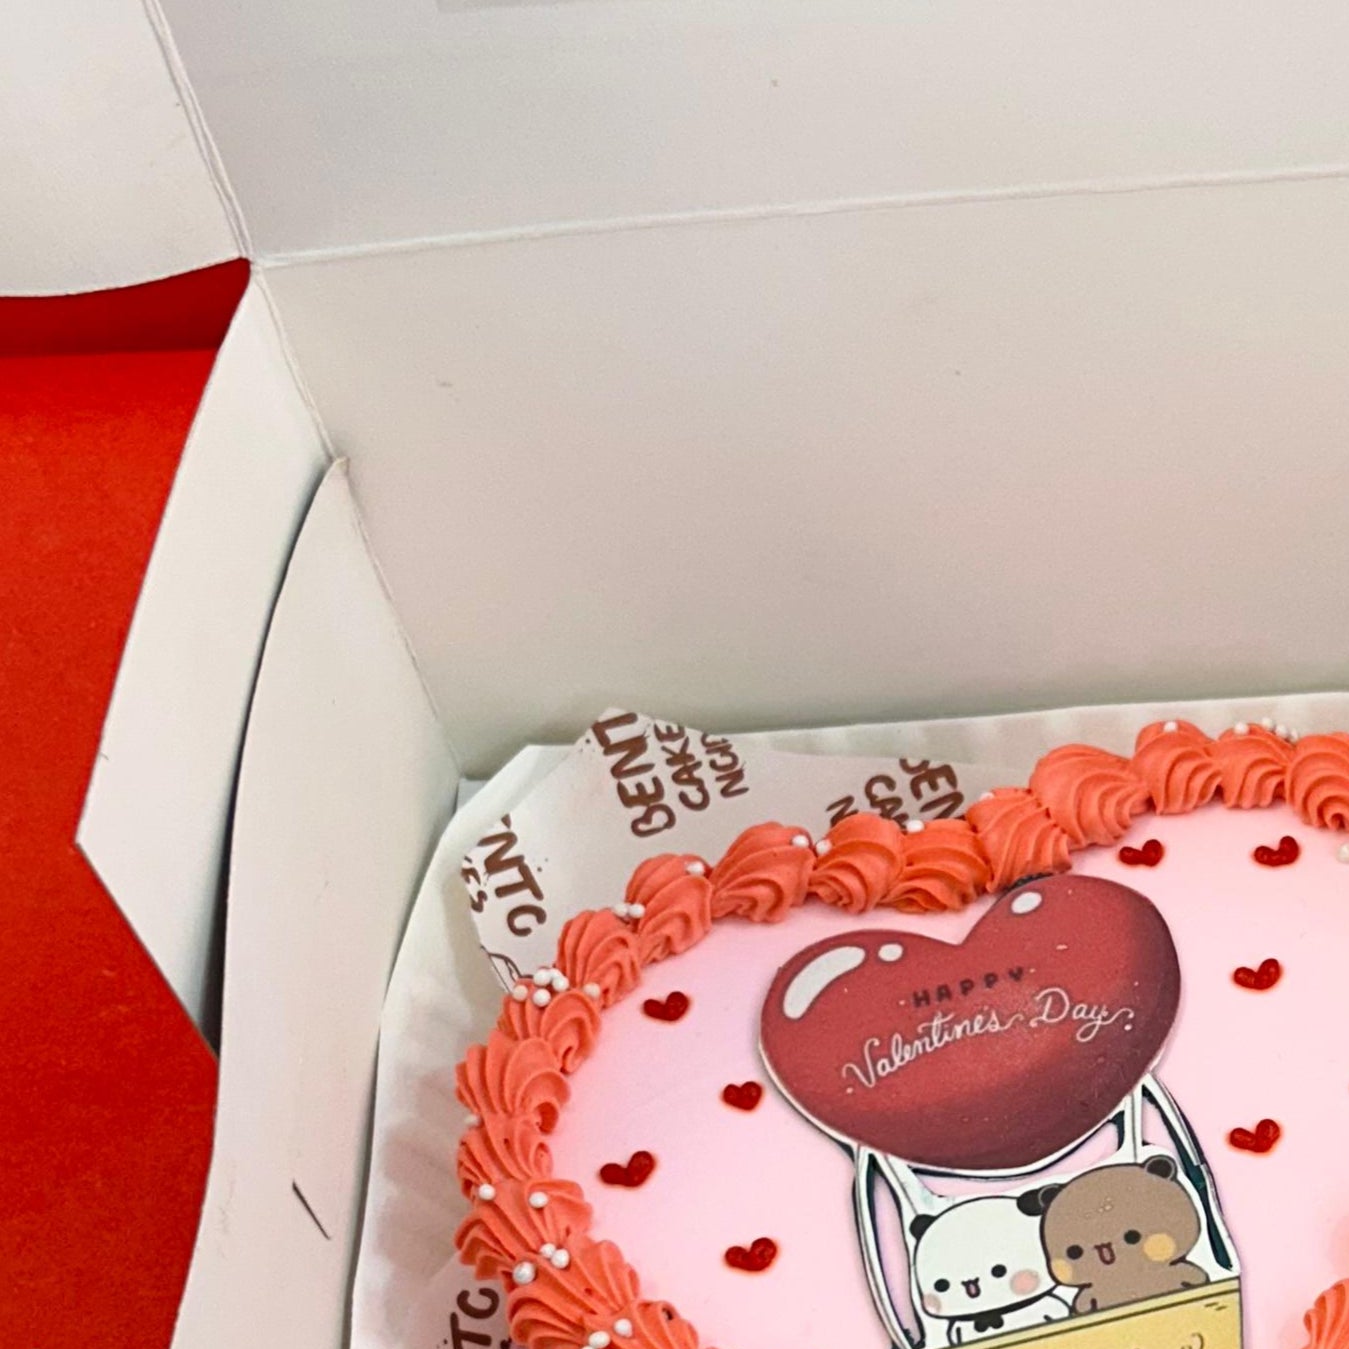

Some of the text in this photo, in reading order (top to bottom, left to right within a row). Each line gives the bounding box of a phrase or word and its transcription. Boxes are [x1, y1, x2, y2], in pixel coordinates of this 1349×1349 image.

[592, 711, 677, 838] BENT
[654, 722, 710, 812] CAKE
[911, 965, 1025, 1009] HAPPY
[841, 986, 1135, 1089] Valentine's Day
